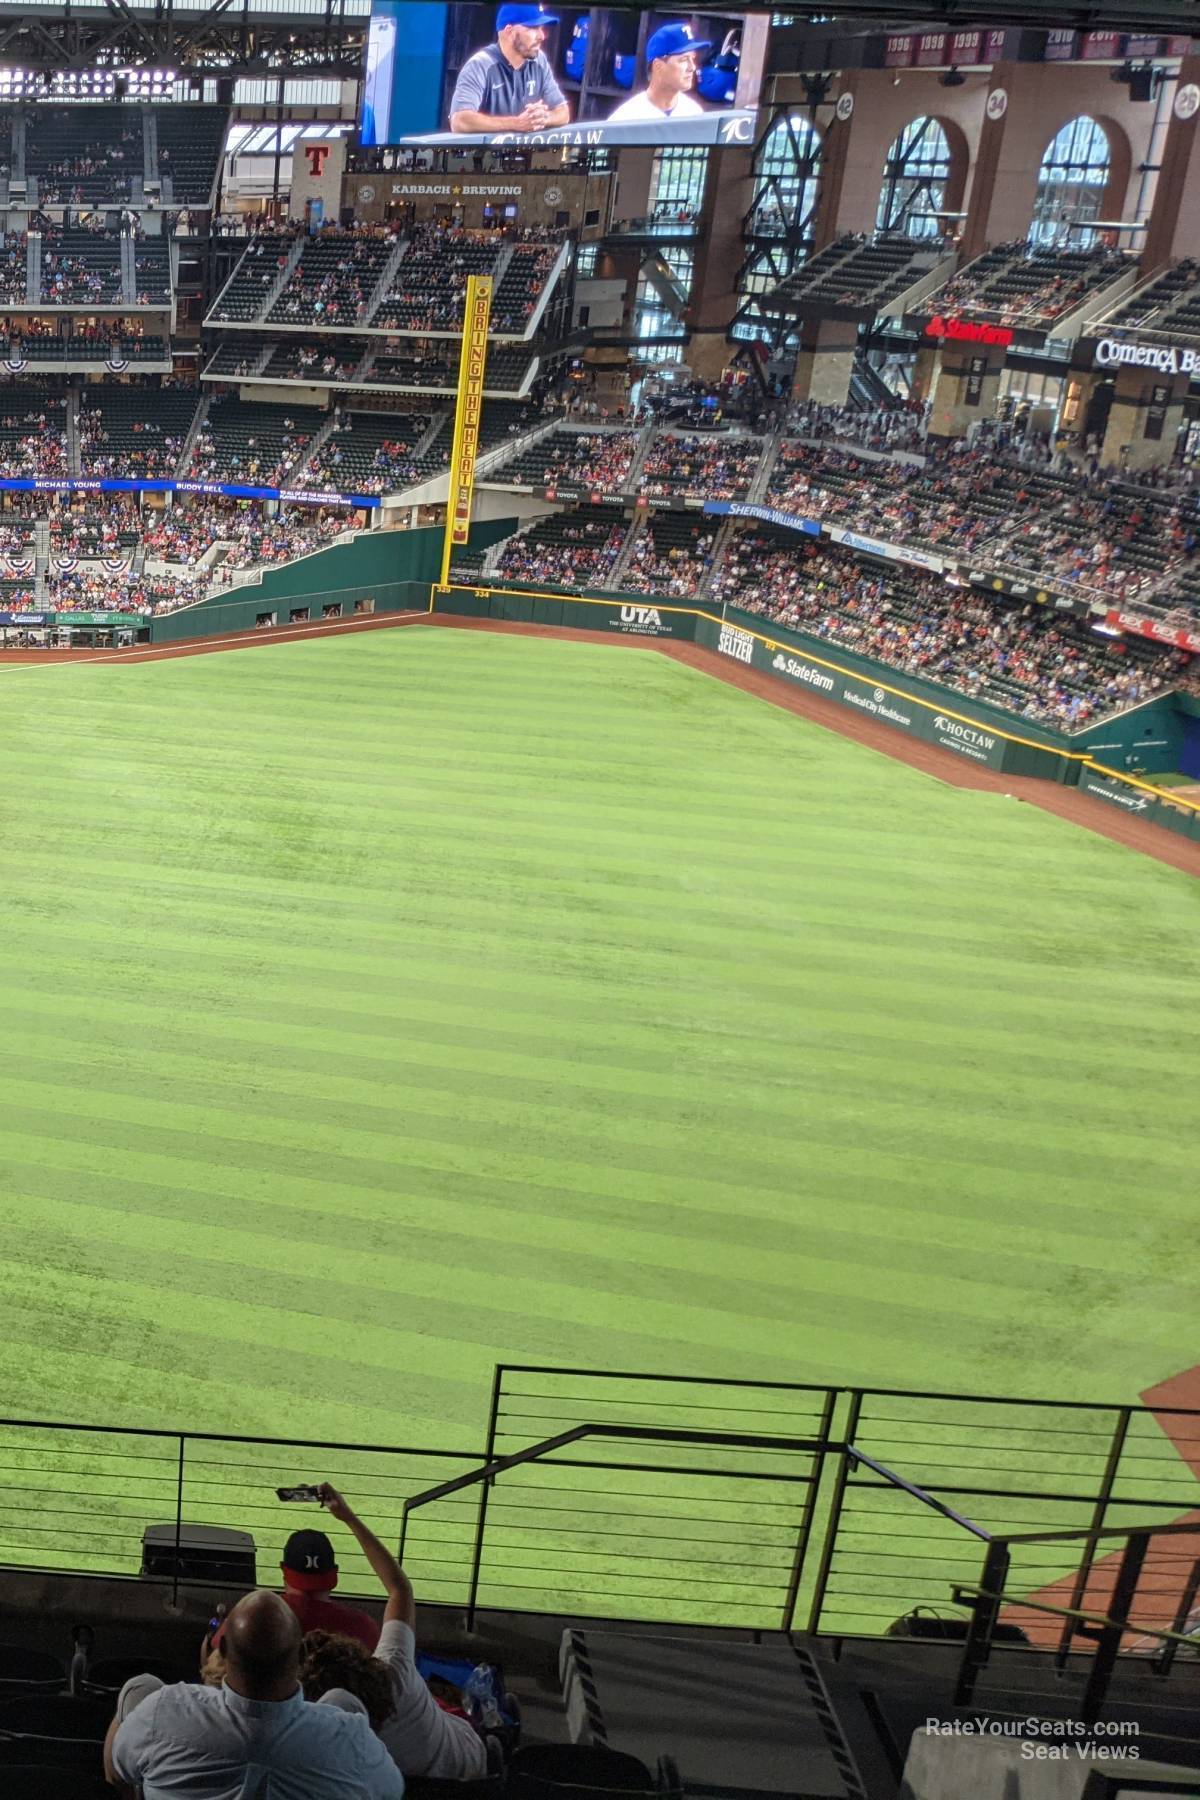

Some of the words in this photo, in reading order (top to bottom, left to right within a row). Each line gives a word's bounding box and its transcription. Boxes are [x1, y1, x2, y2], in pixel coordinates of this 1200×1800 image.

[838, 94, 852, 114] 42
[990, 95, 1005, 113] 34
[305, 146, 331, 177] T
[392, 184, 451, 196] KARBACH
[461, 184, 522, 196] BREWING
[470, 300, 488, 376] BRING
[466, 380, 479, 424] THE
[459, 428, 476, 486] HEAT
[35, 481, 72, 489] MICHAEL
[73, 481, 101, 489] YOUNG
[176, 483, 200, 492] BUDDY
[202, 485, 223, 493] BELL
[556, 491, 578, 499] TOYOTA
[602, 495, 624, 504] TOYOTA
[648, 499, 671, 508] TOYOTA
[621, 605, 662, 626] UTA
[718, 633, 754, 664] SELTZER
[934, 716, 996, 750] CHOCTAW
